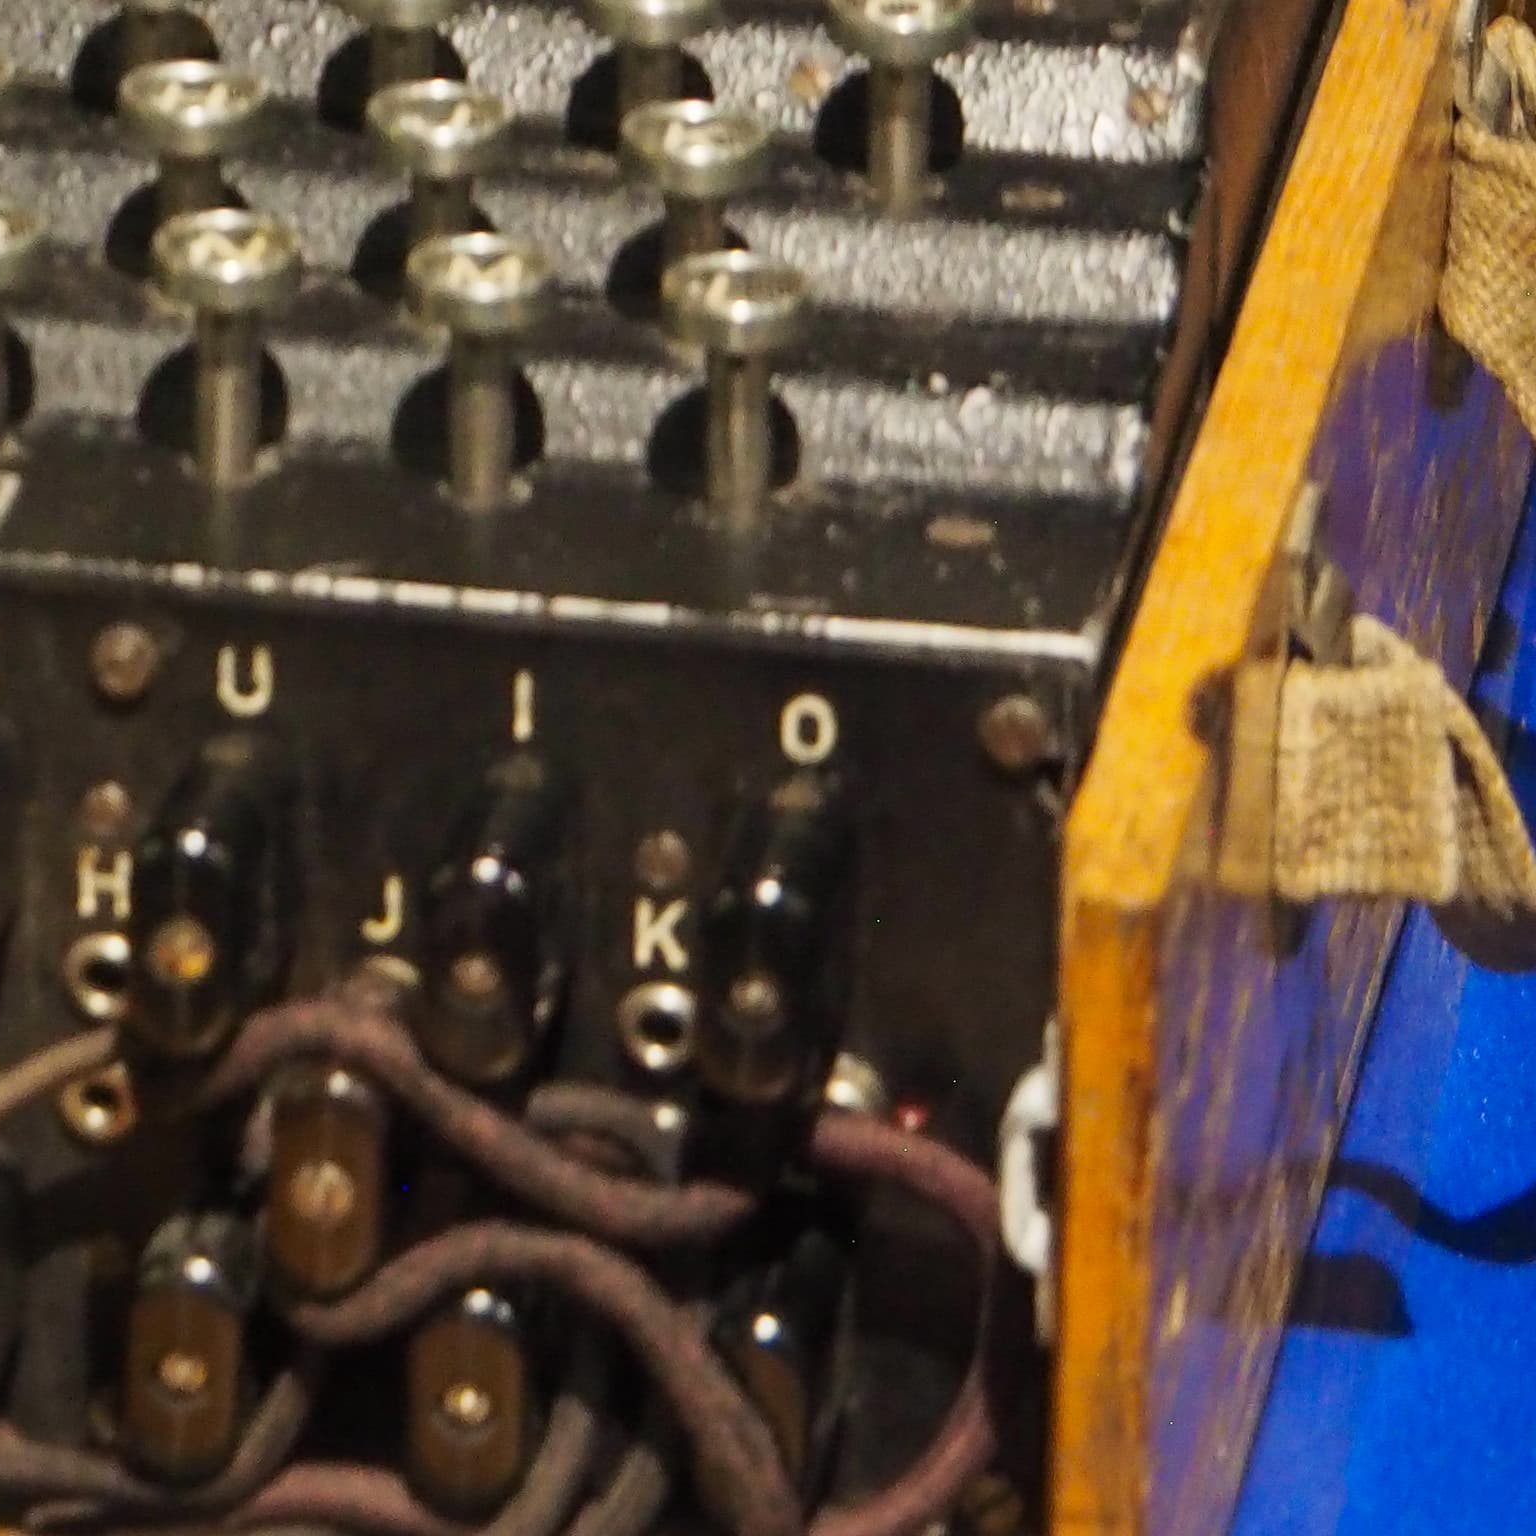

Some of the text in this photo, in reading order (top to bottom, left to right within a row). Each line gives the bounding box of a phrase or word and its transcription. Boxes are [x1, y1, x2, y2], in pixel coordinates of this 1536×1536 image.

[215, 646, 274, 718] U
[511, 670, 535, 742] I
[779, 692, 839, 765] O
[76, 847, 133, 919] H
[360, 874, 405, 944] J
[632, 898, 689, 971] K
